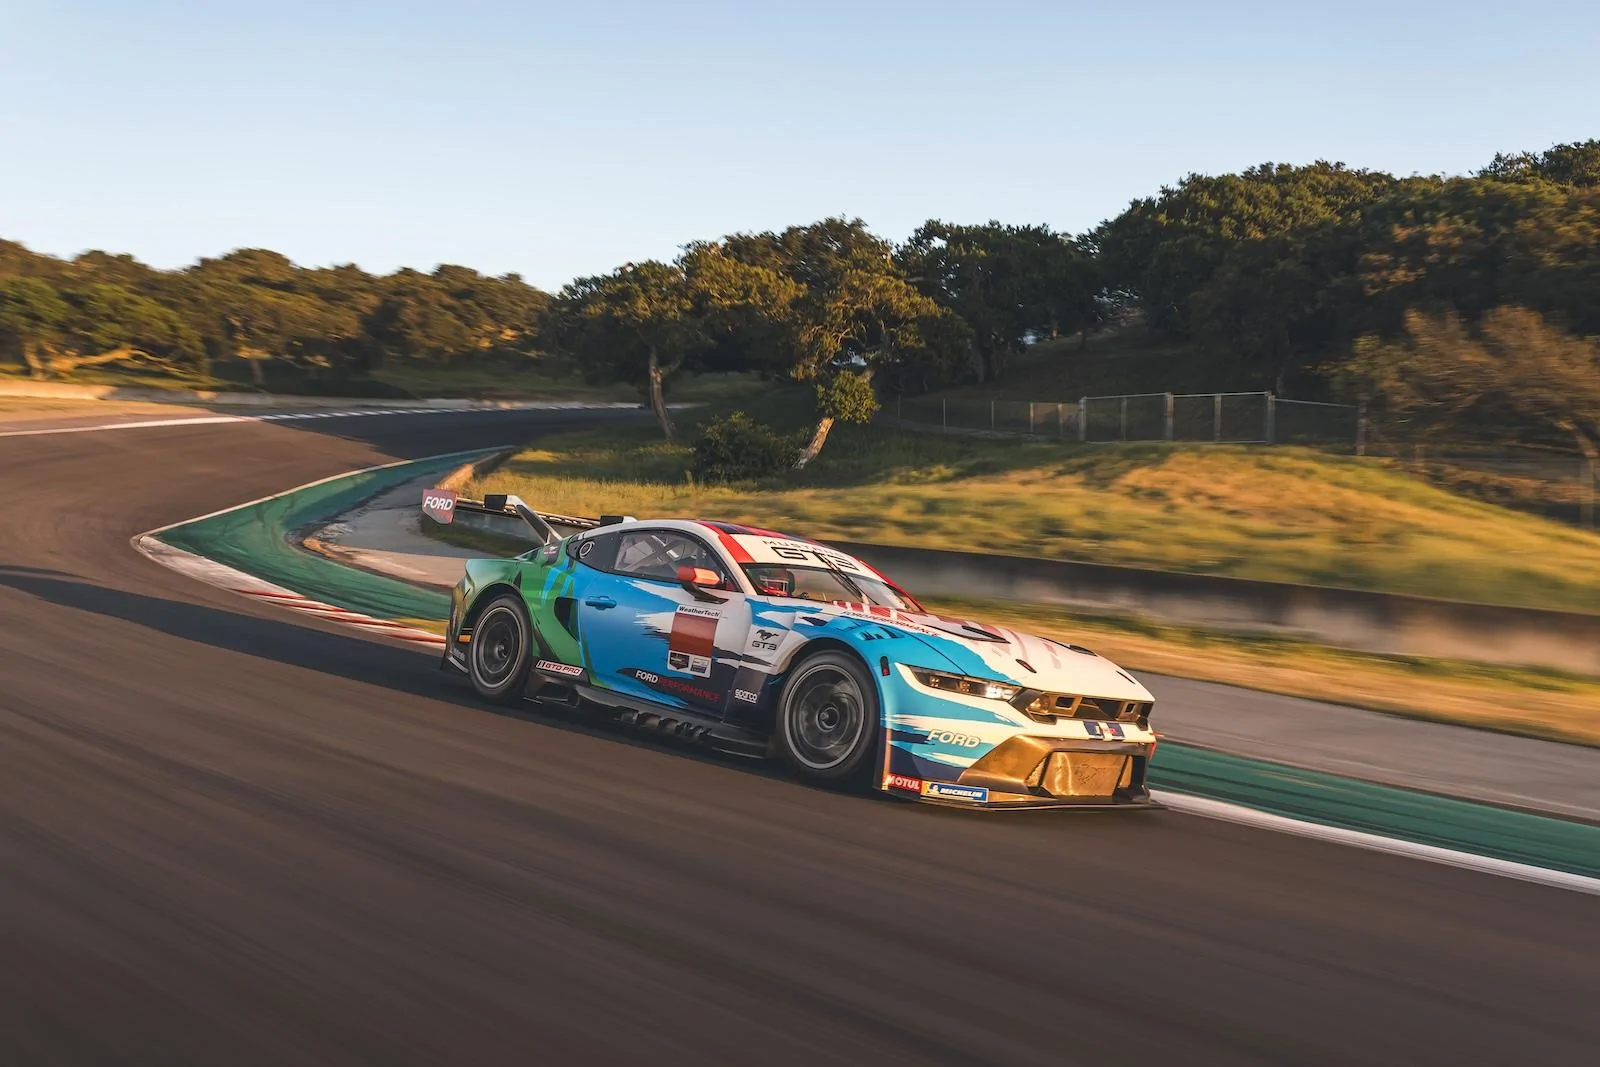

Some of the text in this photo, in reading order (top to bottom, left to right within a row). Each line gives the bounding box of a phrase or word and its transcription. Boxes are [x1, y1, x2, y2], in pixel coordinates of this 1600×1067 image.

[423, 495, 453, 510] FORD
[752, 640, 778, 650] GT3
[562, 666, 580, 674] PRO
[635, 670, 721, 702] FORD PERFORMANCE
[734, 688, 758, 702] sparco
[926, 729, 981, 748] FORD
[885, 775, 920, 790] MOTUL
[939, 787, 983, 798] MICHELIN
